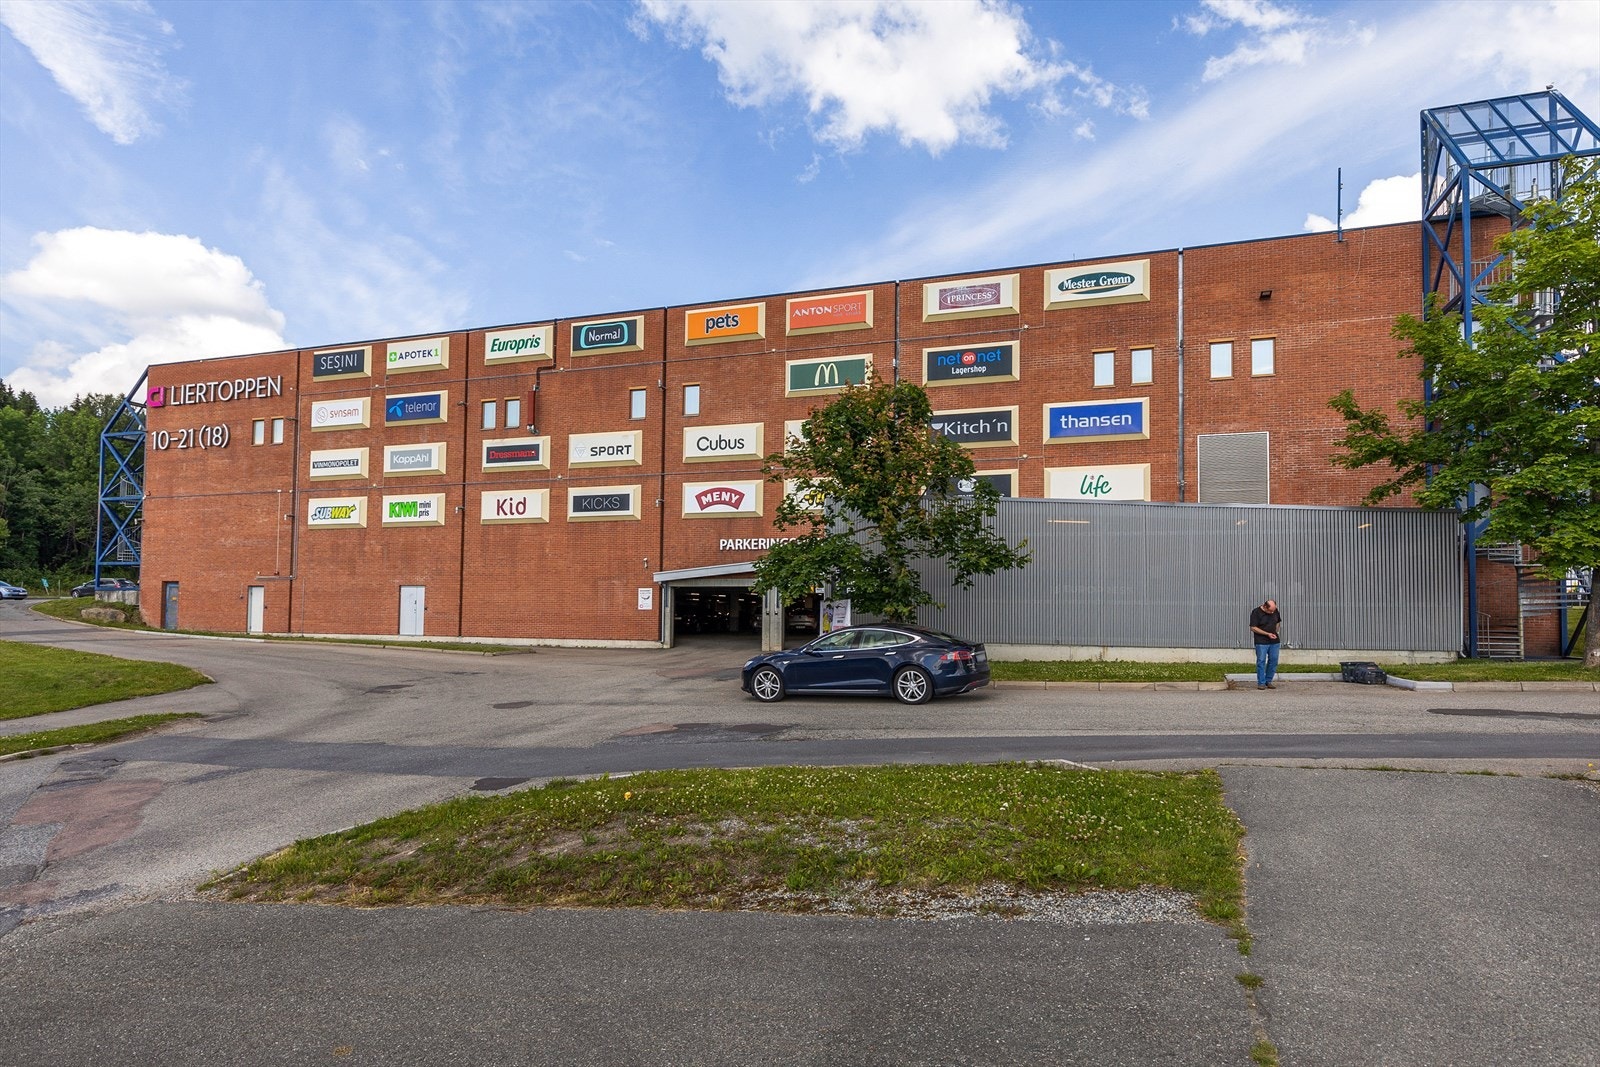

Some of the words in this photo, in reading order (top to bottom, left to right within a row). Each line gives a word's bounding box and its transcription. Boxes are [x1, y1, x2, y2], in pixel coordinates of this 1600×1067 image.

[1062, 279, 1096, 290] Mester
[1099, 275, 1131, 286] Grønn
[792, 306, 832, 318] ANTON
[833, 302, 862, 313] SPORT
[705, 313, 739, 334] pets
[588, 328, 621, 342] Normal
[490, 334, 541, 354] Europris
[320, 353, 358, 371] SESINI
[398, 349, 433, 361] APOTEK
[434, 348, 439, 357] 1
[951, 365, 987, 376] Lagershop
[170, 375, 281, 406] LIERTOPPEN
[405, 402, 437, 413] telenor
[1060, 413, 1132, 430] thansen
[151, 428, 194, 450] 10-21
[199, 423, 229, 449] (18)
[696, 434, 745, 451] Cubus
[489, 449, 537, 459] Dressmann
[590, 445, 632, 457] SPORT
[313, 459, 358, 469] VINMONOPOLET
[393, 453, 429, 465] KappAhl
[582, 497, 620, 509] KICKS
[700, 491, 740, 505] MENY
[311, 504, 357, 521] SUBWAY
[389, 501, 418, 518] KIWI
[419, 509, 430, 518] pris
[496, 496, 527, 516] Kid
